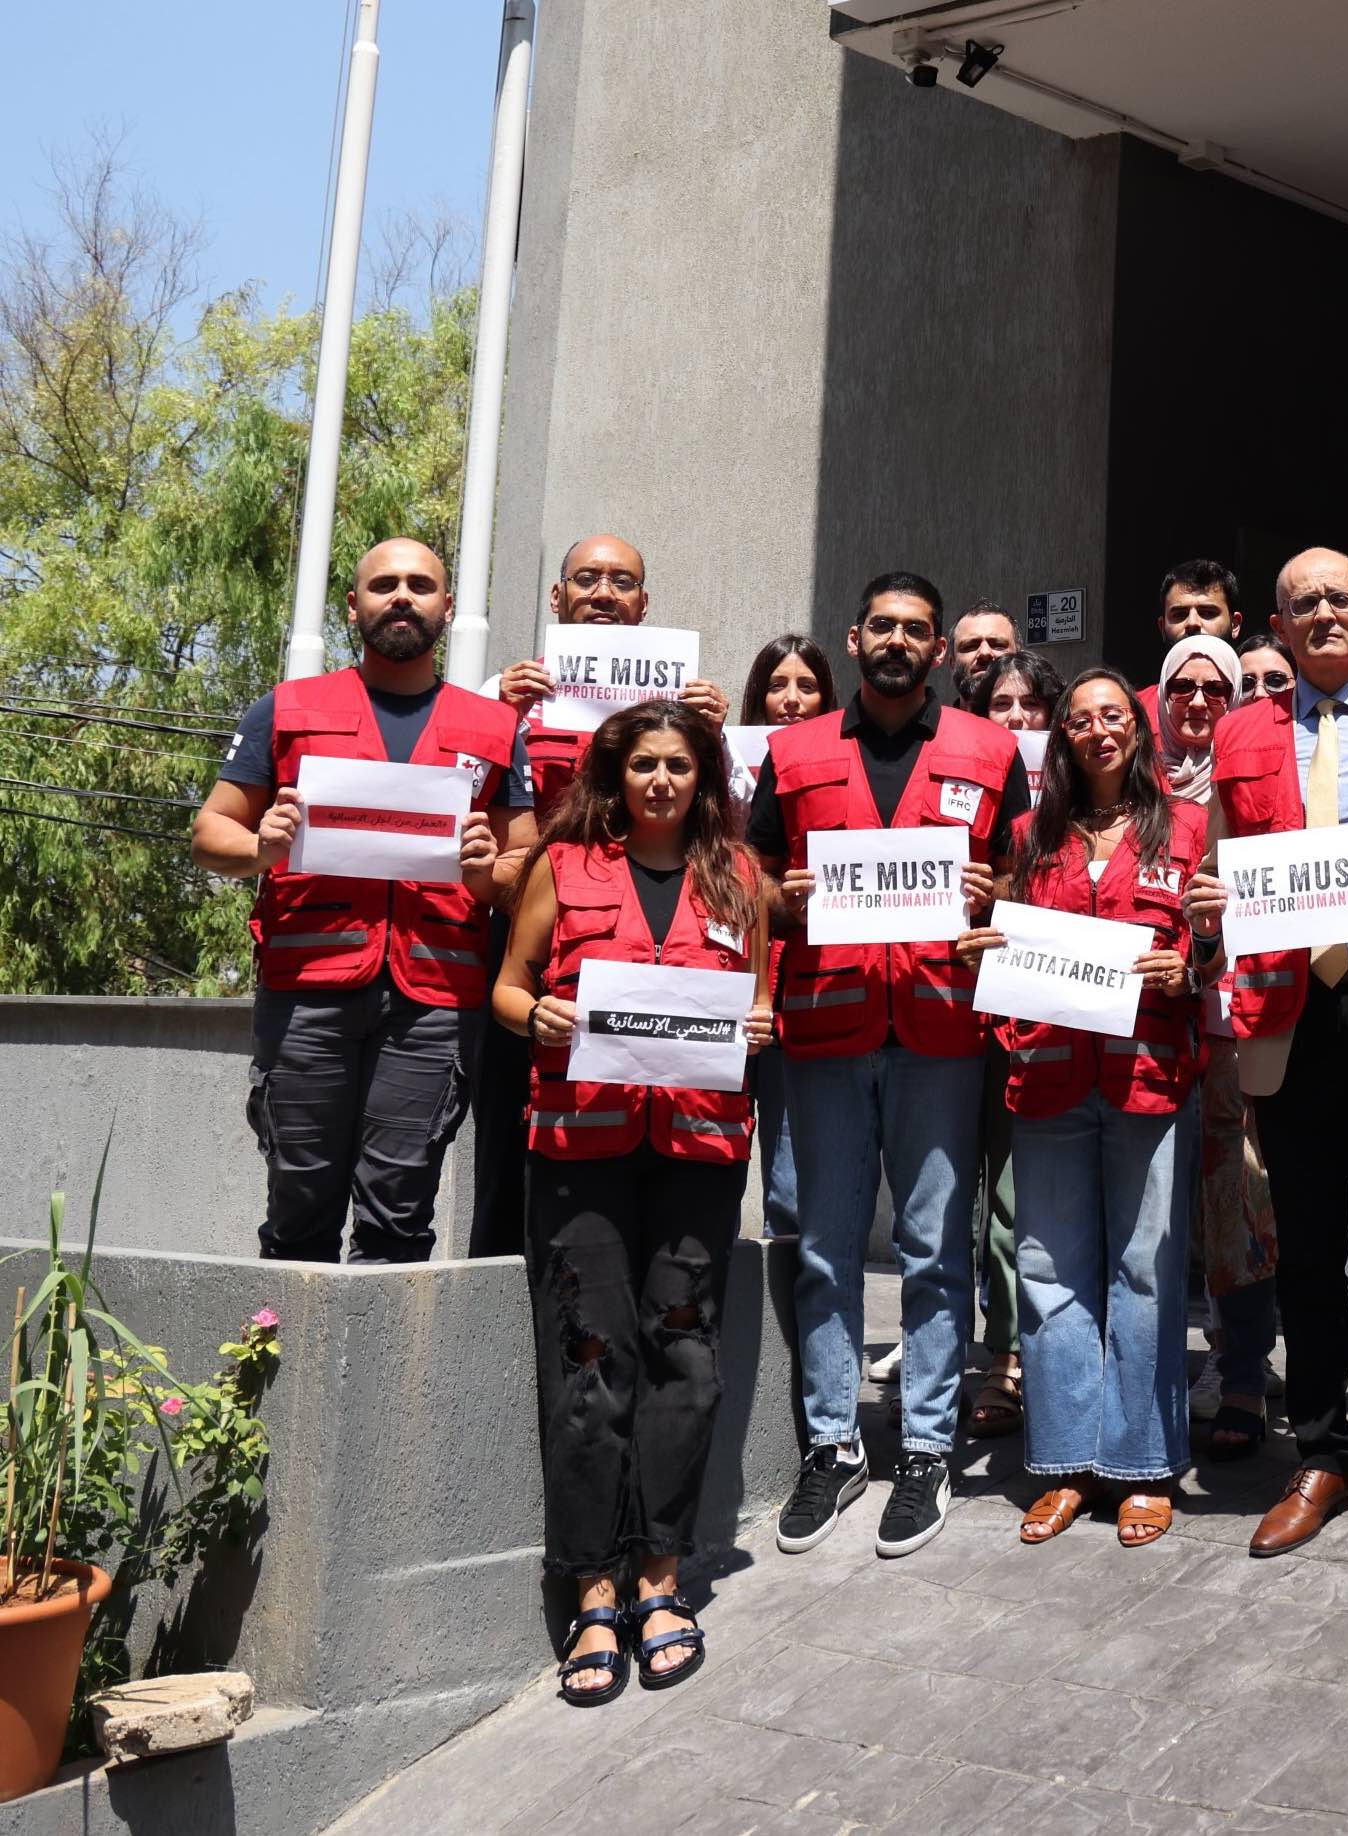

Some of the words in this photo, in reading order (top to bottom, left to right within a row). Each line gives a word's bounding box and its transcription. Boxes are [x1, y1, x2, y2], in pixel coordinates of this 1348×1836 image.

[1060, 596, 1077, 611] 20
[1028, 616, 1047, 629] 826
[558, 655, 598, 684] WE
[610, 657, 686, 689] MUST
[947, 797, 972, 812] IFRC
[822, 863, 864, 892] WE
[877, 860, 954, 891] MUST
[1233, 866, 1276, 899] WE
[822, 892, 953, 910] #ACTFORHUMANITY
[997, 946, 1130, 990] #NOTATARGET
